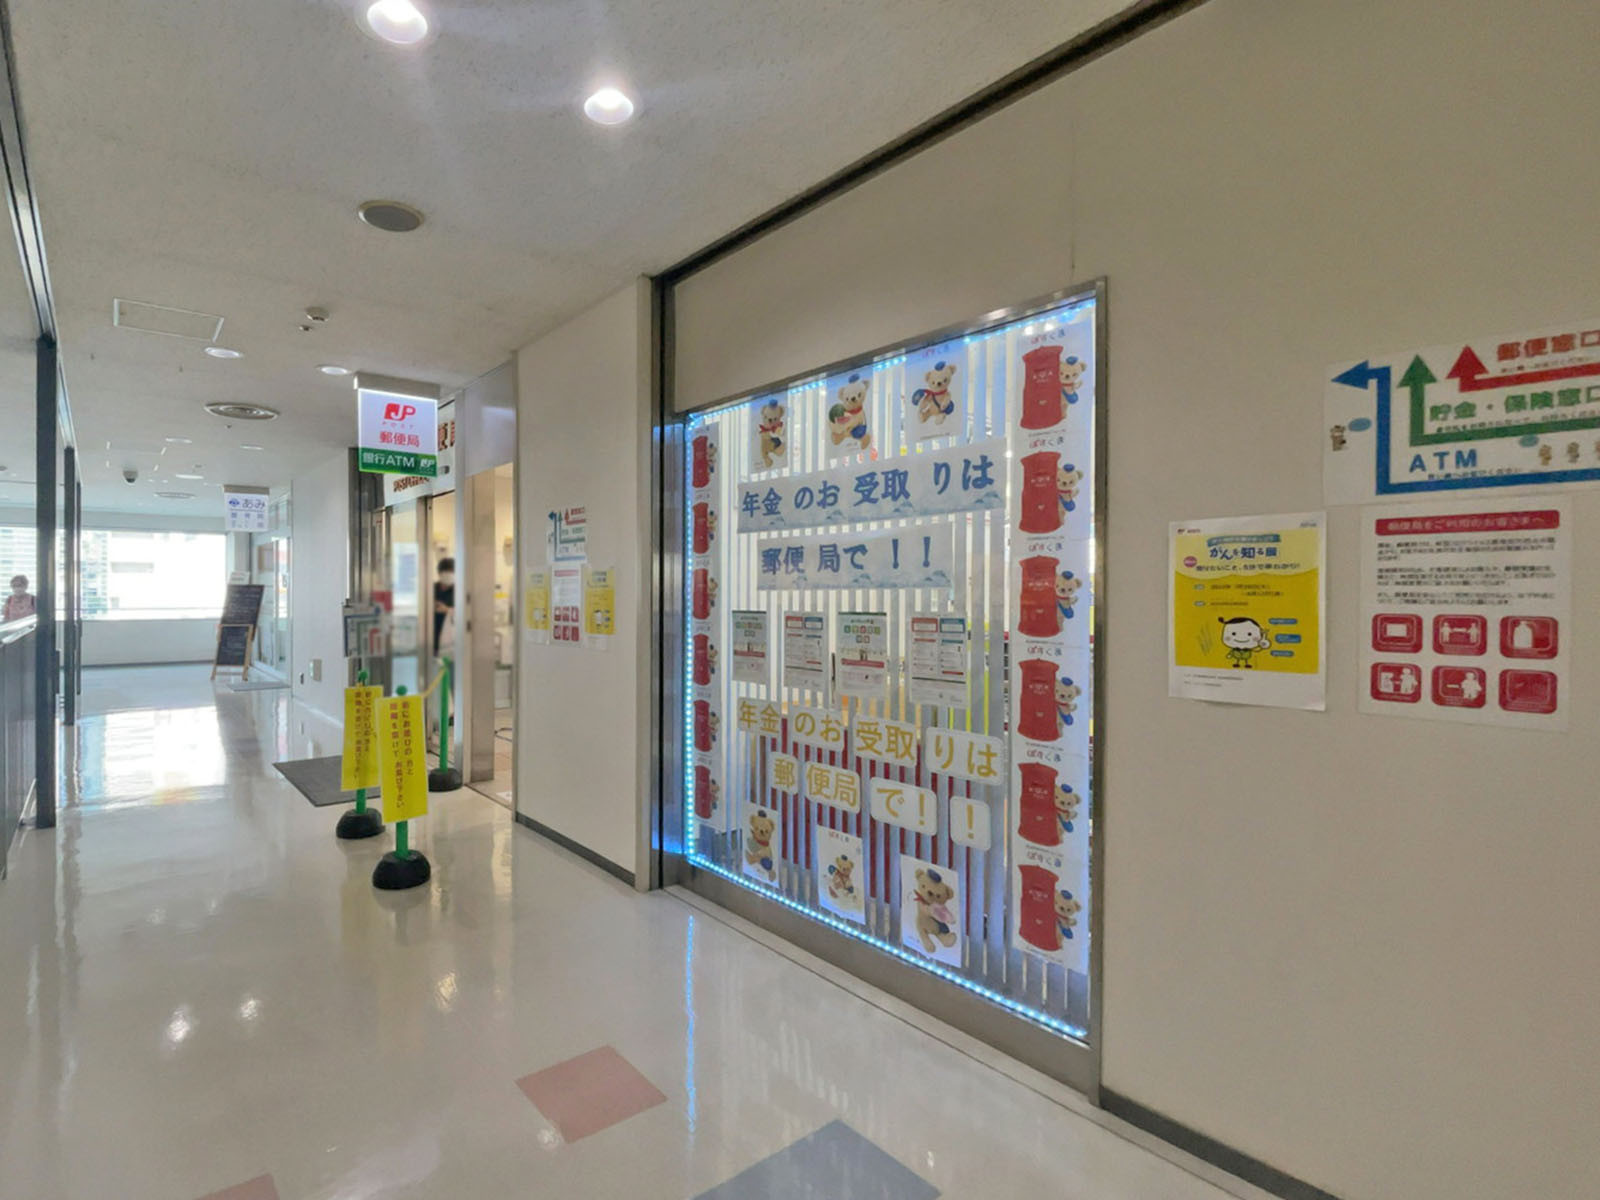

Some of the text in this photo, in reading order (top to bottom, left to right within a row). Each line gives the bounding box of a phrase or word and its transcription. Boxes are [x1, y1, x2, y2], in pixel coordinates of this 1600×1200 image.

[379, 431, 420, 447] 郵便局
[1409, 449, 1478, 472] ATM
[742, 454, 995, 517] 年金のお受取りは
[242, 498, 265, 509] あみ
[739, 701, 998, 778] 年金のお受取りは
